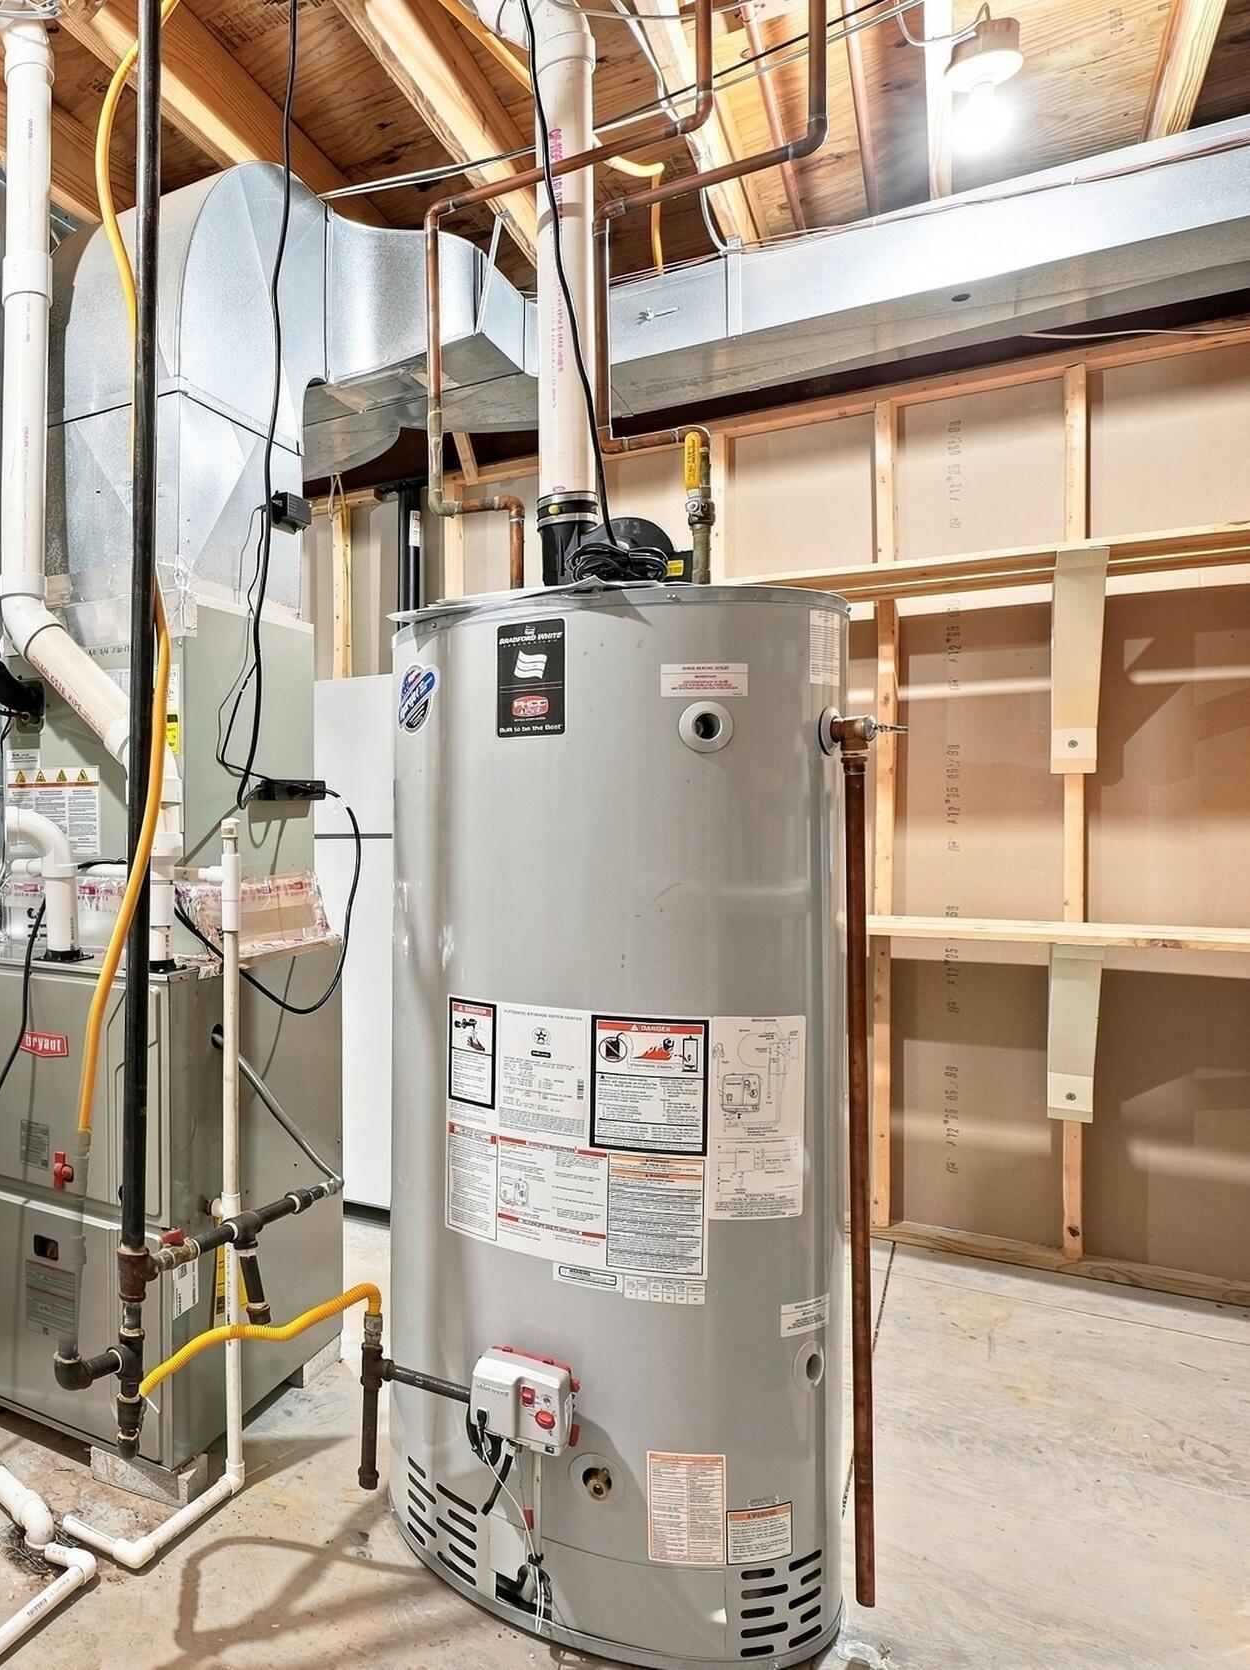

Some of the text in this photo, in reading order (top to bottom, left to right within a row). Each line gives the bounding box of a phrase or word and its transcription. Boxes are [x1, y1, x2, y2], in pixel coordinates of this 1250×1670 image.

[499, 632, 563, 645] BRADFORD WHITE
[464, 1006, 488, 1015] DANGER
[641, 1024, 671, 1032] DANGER
[25, 1033, 61, 1052] bryant
